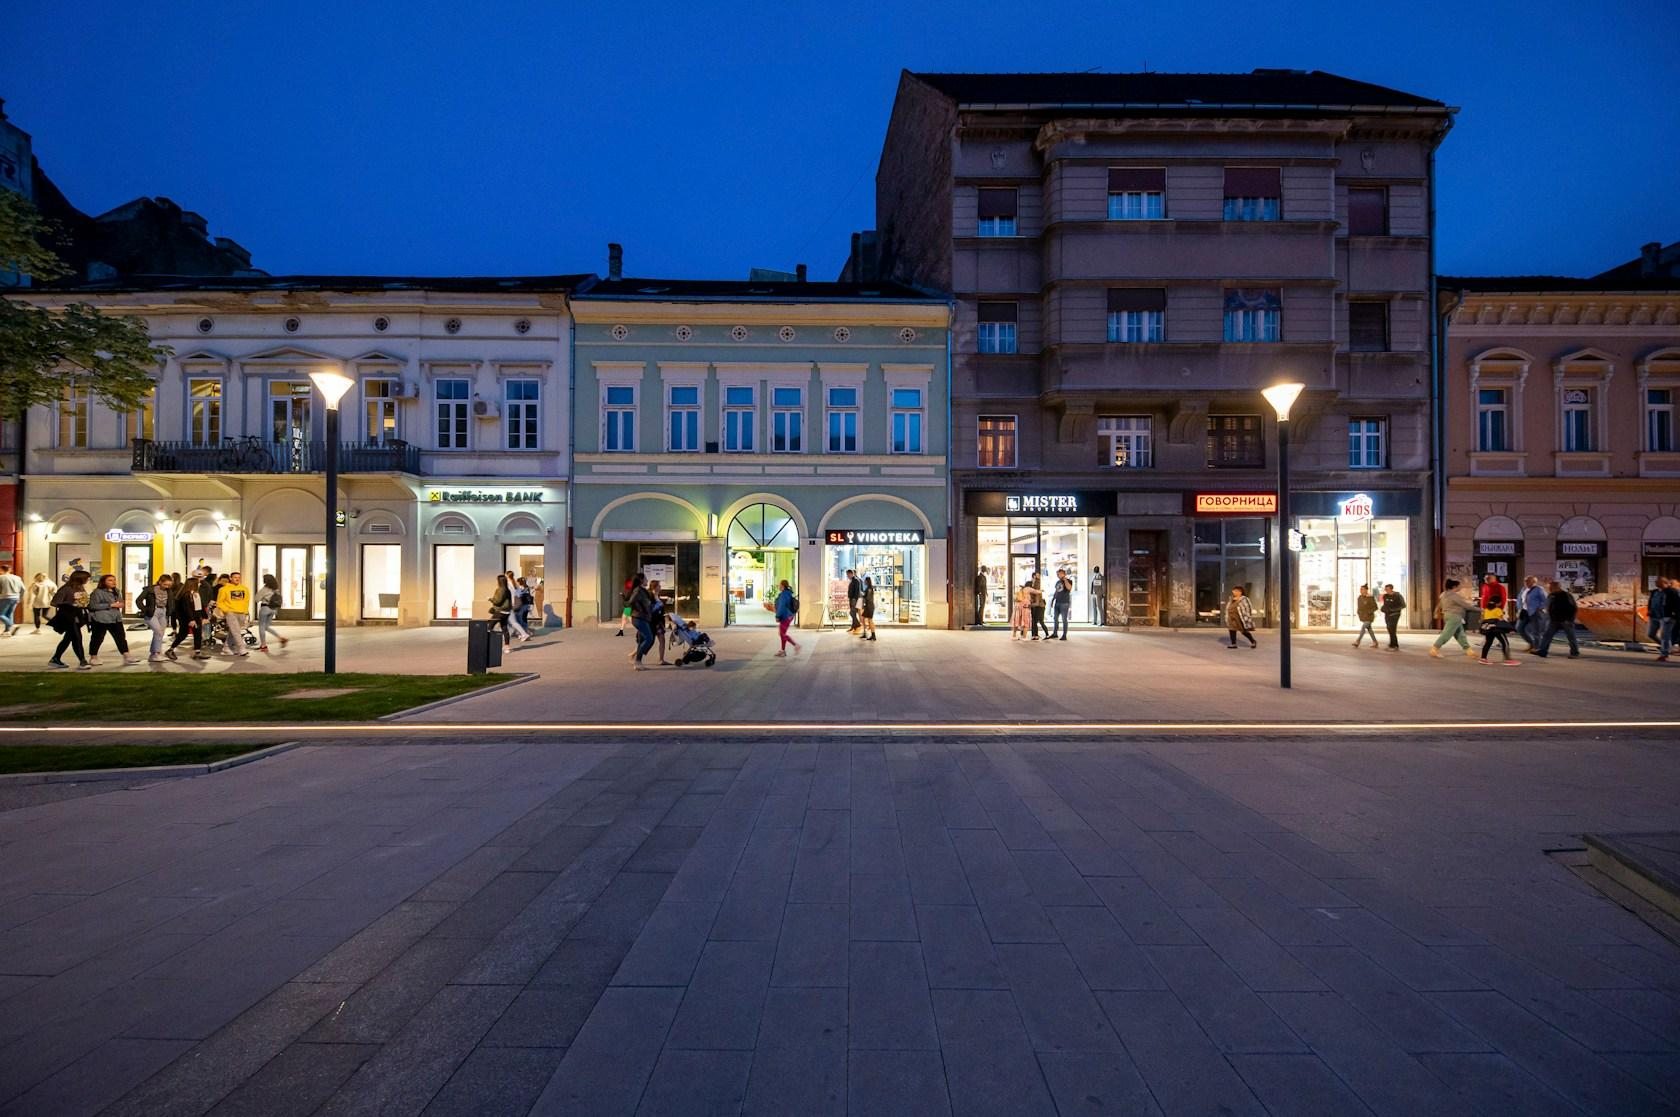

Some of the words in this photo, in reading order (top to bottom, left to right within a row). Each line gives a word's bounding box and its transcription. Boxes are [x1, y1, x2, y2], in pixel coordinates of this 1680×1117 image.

[442, 490, 503, 501] Raiffeisen
[505, 491, 543, 502] BANK
[1022, 495, 1077, 508] MISTER
[1199, 496, 1273, 507] ГОВОРНИЦА
[1345, 504, 1370, 515] KIDS
[830, 533, 844, 542] SL
[857, 532, 920, 542] VINOTEKA
